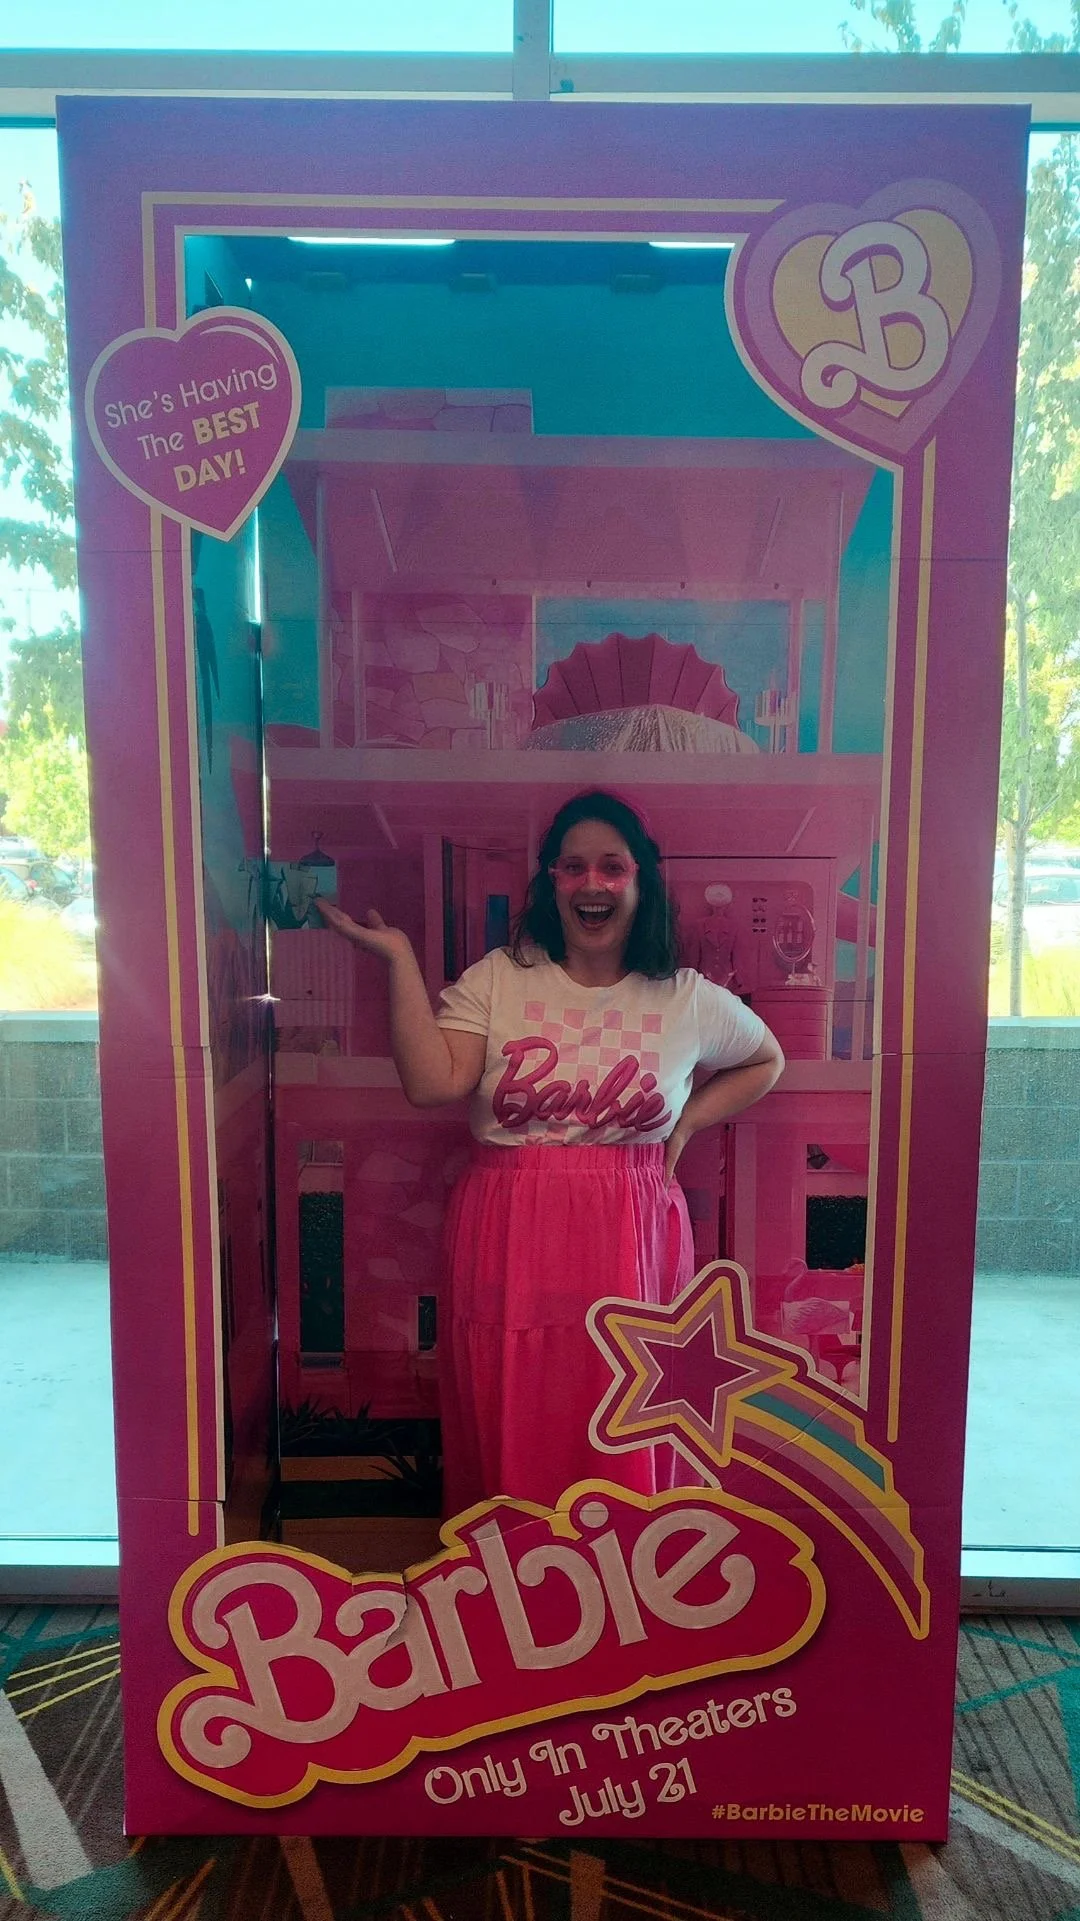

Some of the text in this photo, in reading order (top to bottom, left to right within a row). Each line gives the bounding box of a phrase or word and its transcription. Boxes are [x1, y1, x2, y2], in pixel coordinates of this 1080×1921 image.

[801, 220, 950, 409] B
[104, 363, 278, 428] She's Having
[137, 401, 260, 461] The BEST
[174, 448, 246, 492] DAY!
[493, 1036, 672, 1132] Barbie
[179, 1501, 756, 1768] Barbie
[424, 1687, 797, 1804] Only In Theaters
[559, 1757, 698, 1826] July 21
[711, 1803, 925, 1823] #BarbieTheMovie
